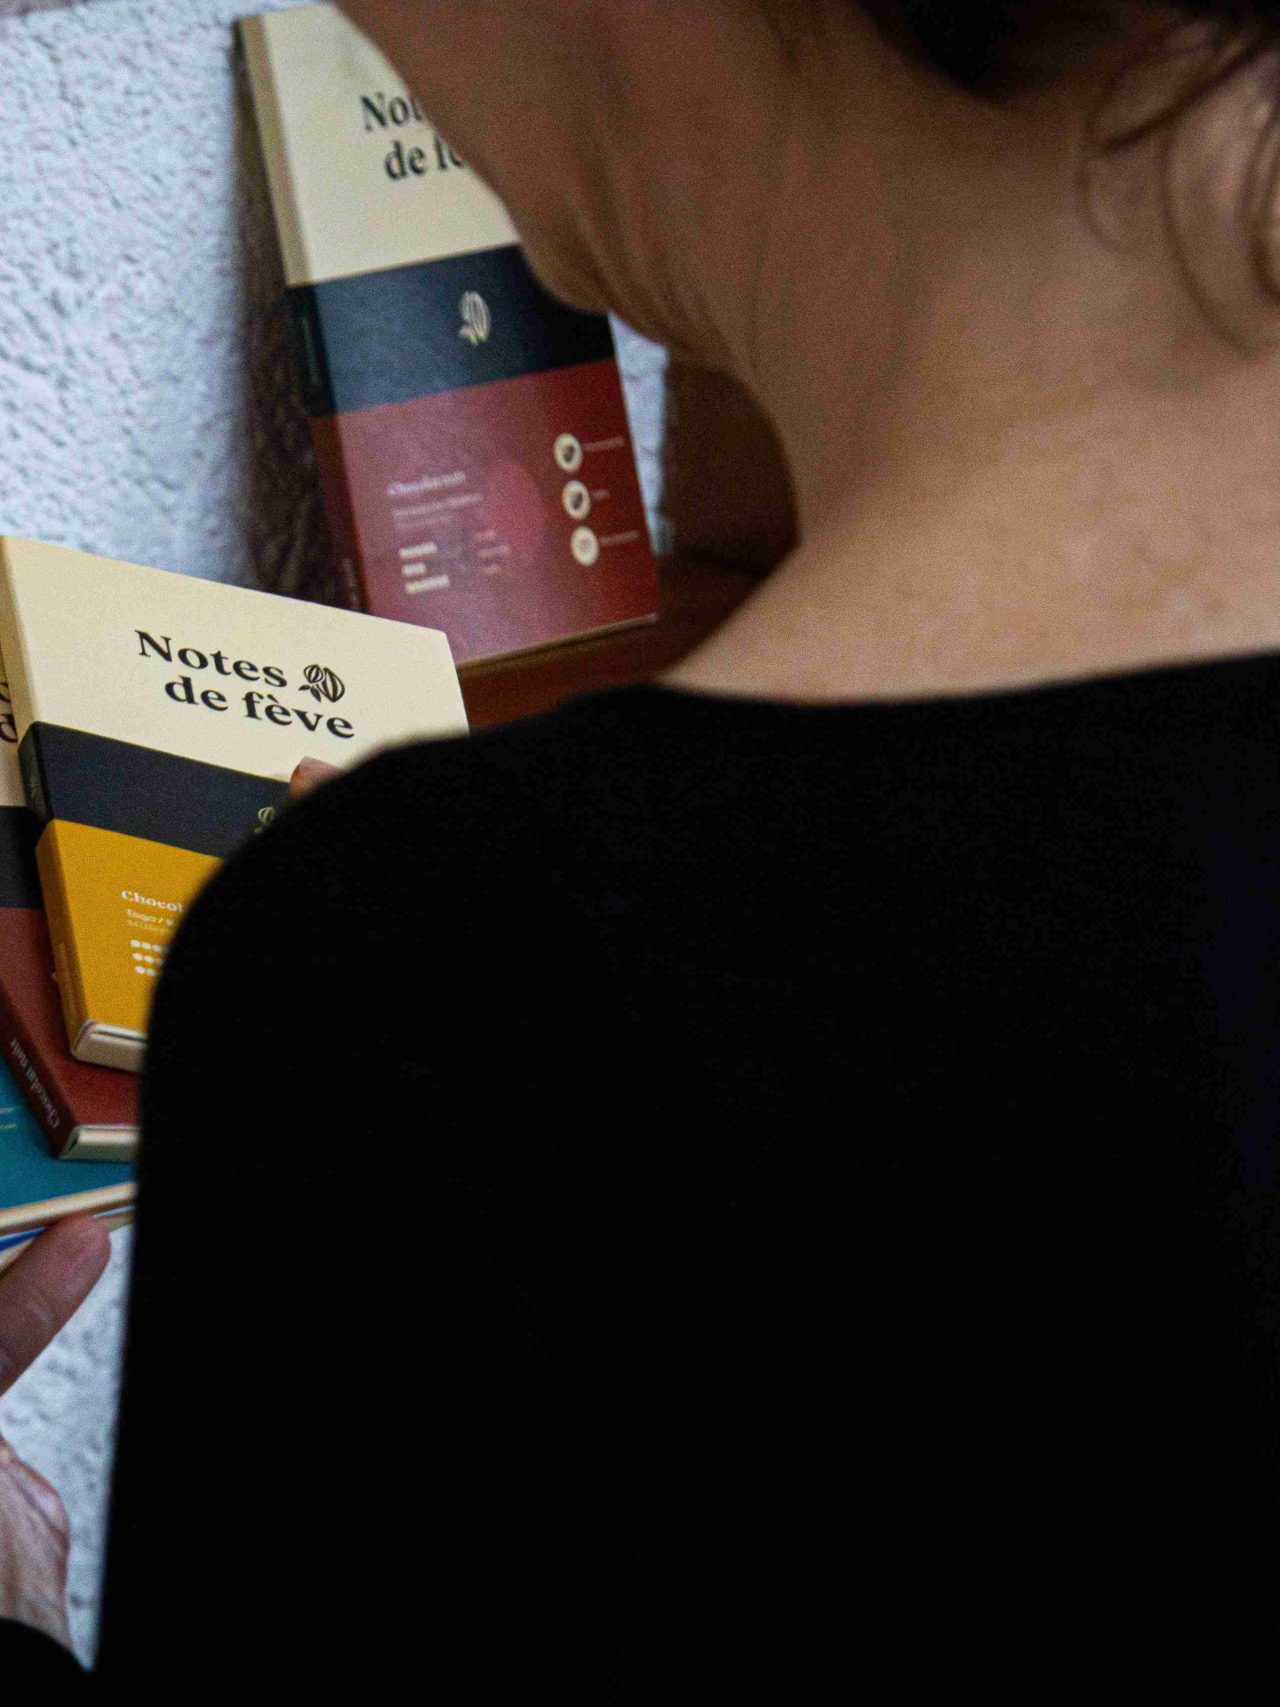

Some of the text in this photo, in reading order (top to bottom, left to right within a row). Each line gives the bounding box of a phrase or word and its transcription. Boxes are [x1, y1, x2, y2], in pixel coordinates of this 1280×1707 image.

[384, 139, 427, 180] de
[135, 629, 288, 688] Notes
[164, 675, 355, 739] de fève
